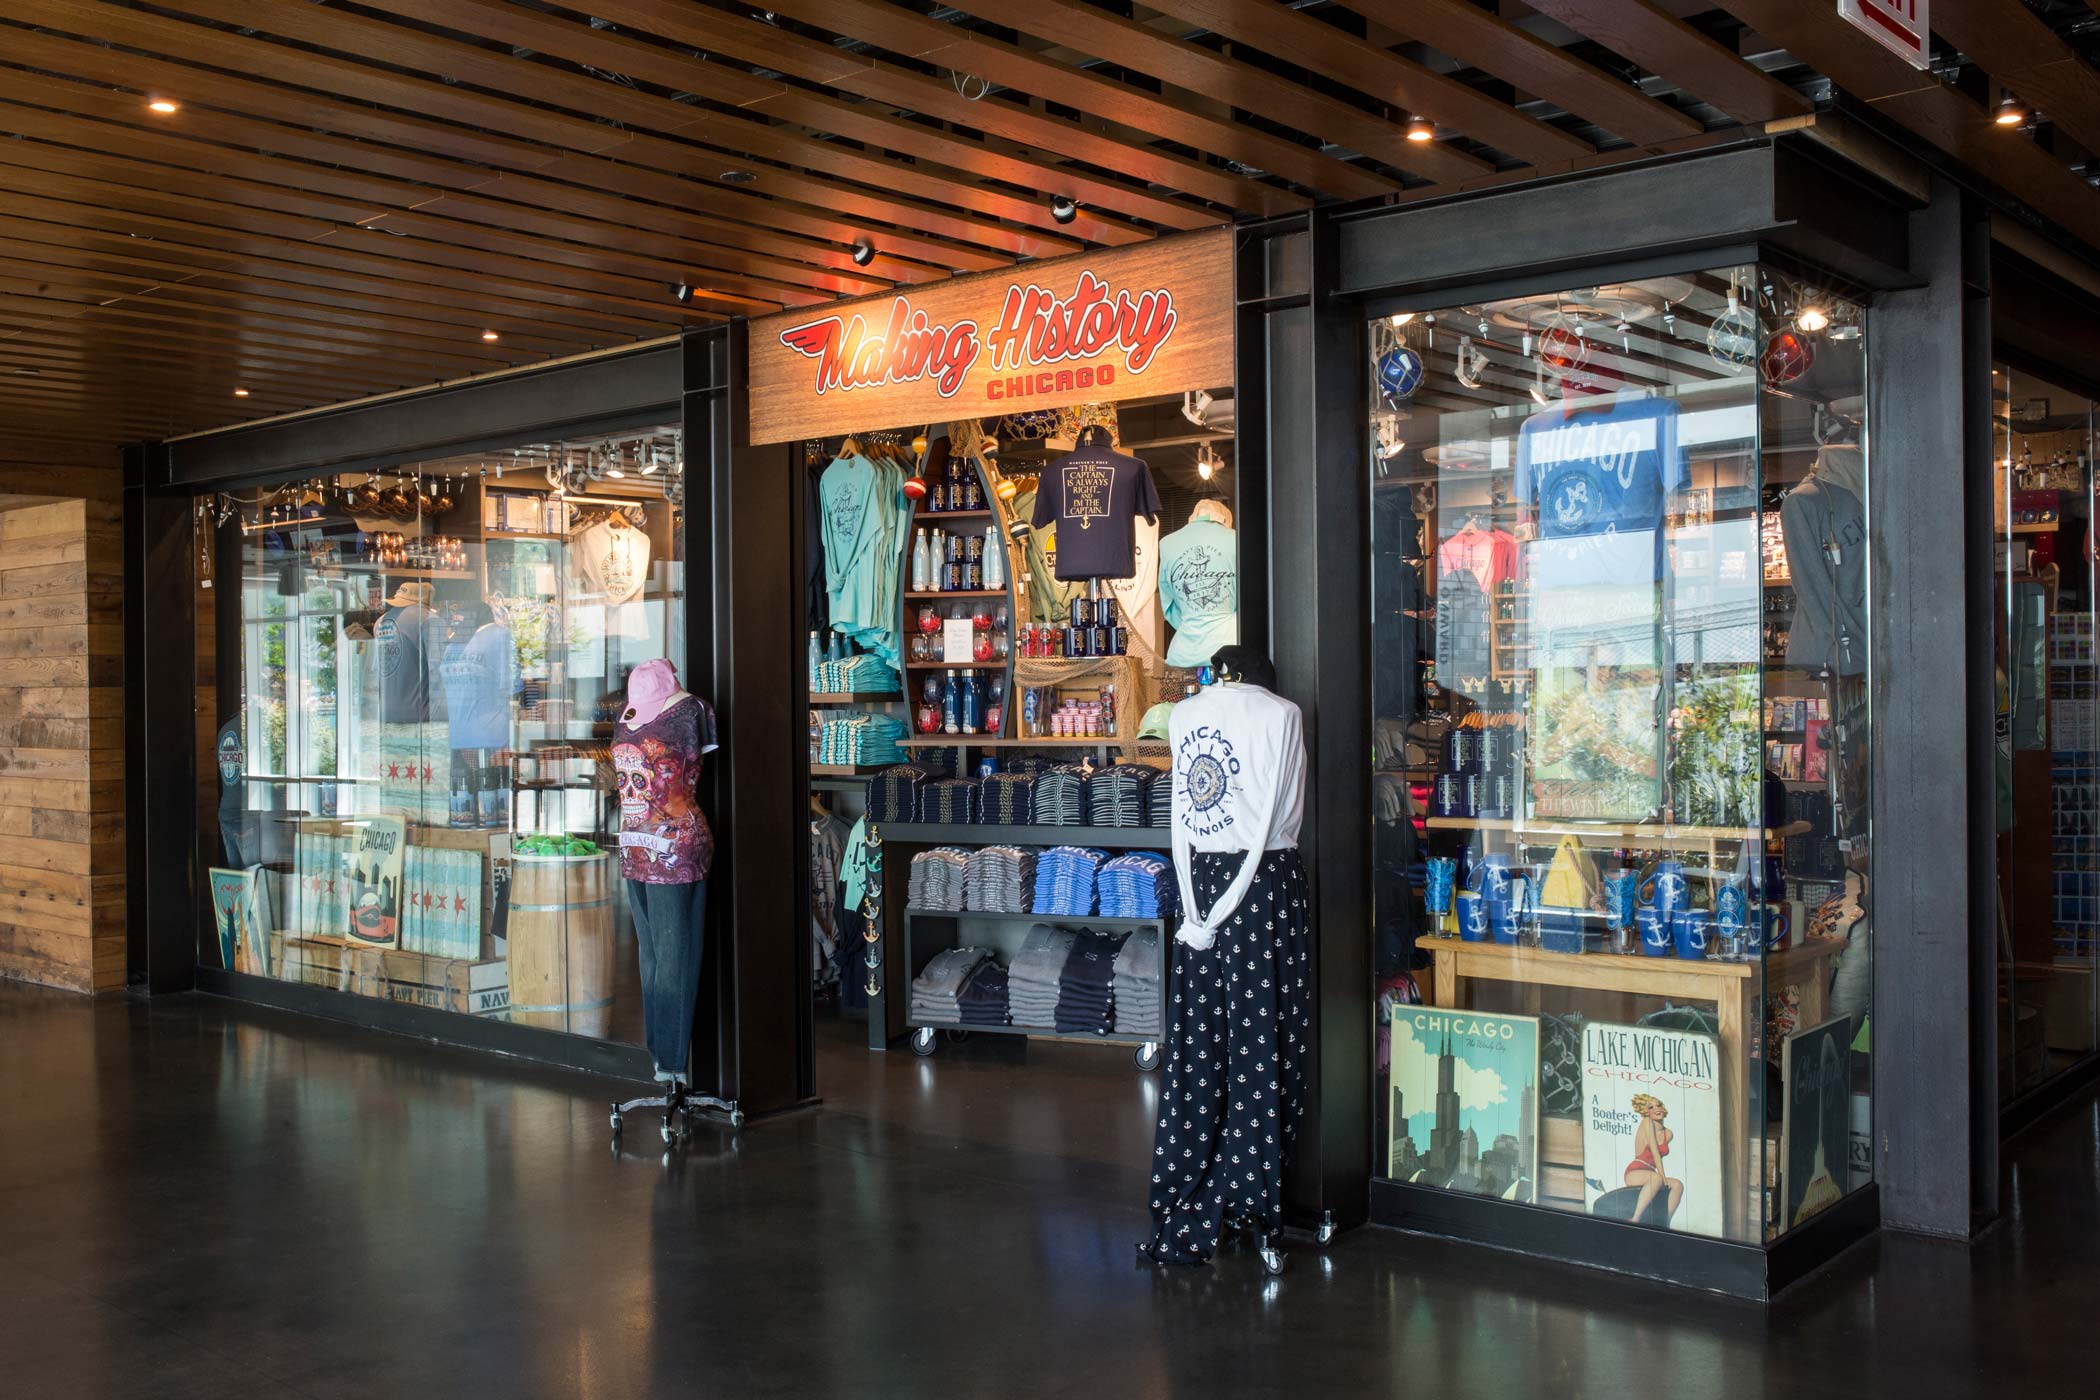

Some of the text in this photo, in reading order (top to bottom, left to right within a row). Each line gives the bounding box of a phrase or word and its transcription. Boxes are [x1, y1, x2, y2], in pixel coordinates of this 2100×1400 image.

[783, 270, 1178, 398] Making History
[987, 364, 1115, 400] CHICAGO
[1070, 471, 1105, 479] CAPTAIN
[1076, 478, 1108, 487] ALWAYS
[1085, 498, 1100, 507] THE
[1171, 563, 1235, 589] Chicago
[359, 828, 397, 855] CHICAGO
[1102, 855, 1165, 875] HICAG
[480, 991, 510, 1009] NAV
[1414, 1014, 1514, 1040] CHICAGO
[1586, 1028, 1713, 1080] LAKE MICHIGAN
[1588, 1067, 1712, 1090] CHICAGO
[1592, 1094, 1599, 1105] A
[1592, 1106, 1638, 1123] Boater's
[1593, 1119, 1632, 1136] Delight!
